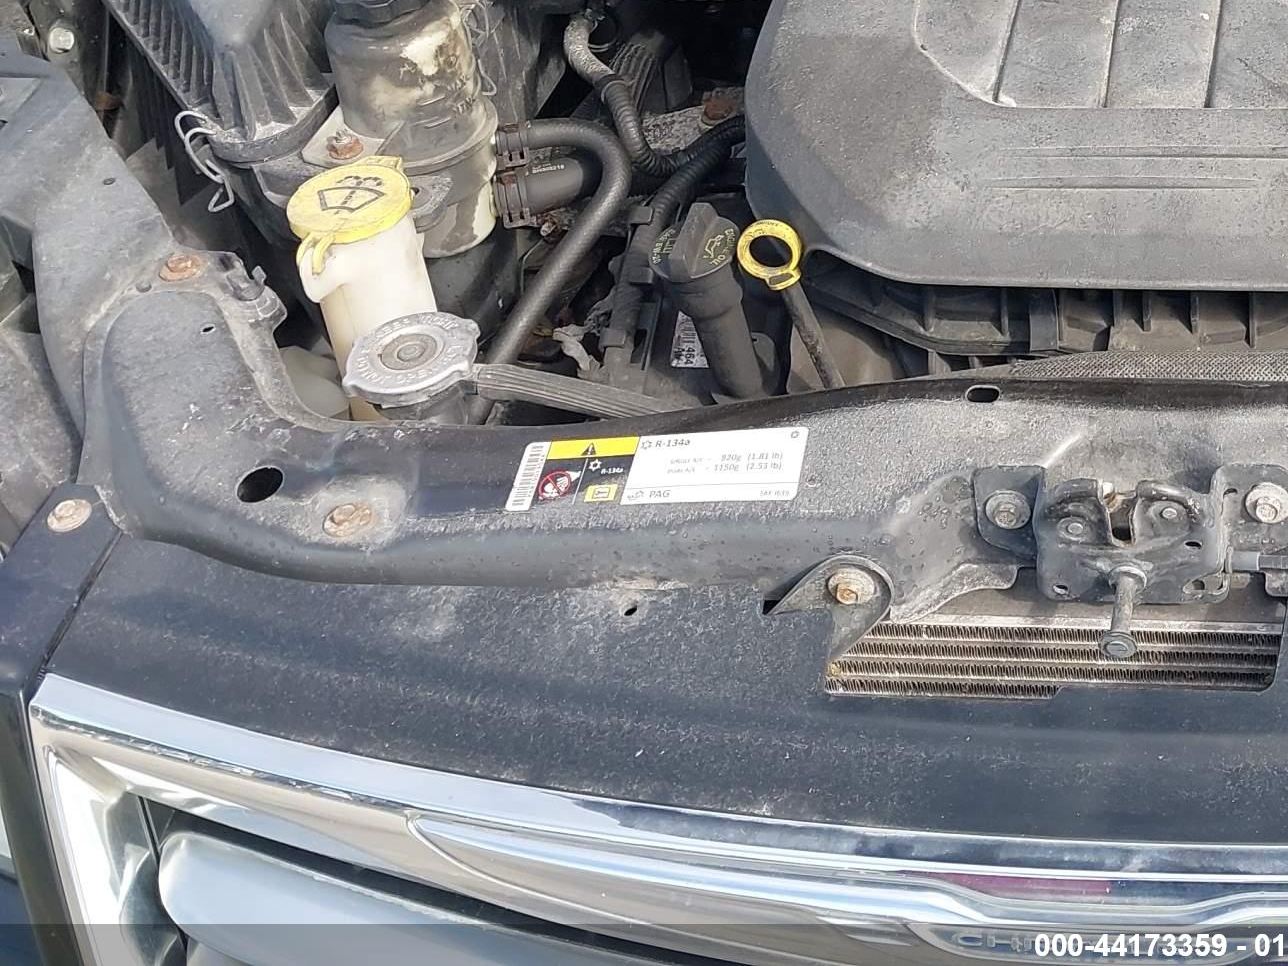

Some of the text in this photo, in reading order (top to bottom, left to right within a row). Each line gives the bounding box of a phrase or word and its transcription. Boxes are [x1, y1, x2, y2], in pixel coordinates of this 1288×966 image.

[655, 438, 691, 449] R-134a
[713, 462, 740, 474] 1150g
[648, 489, 671, 499] PAG
